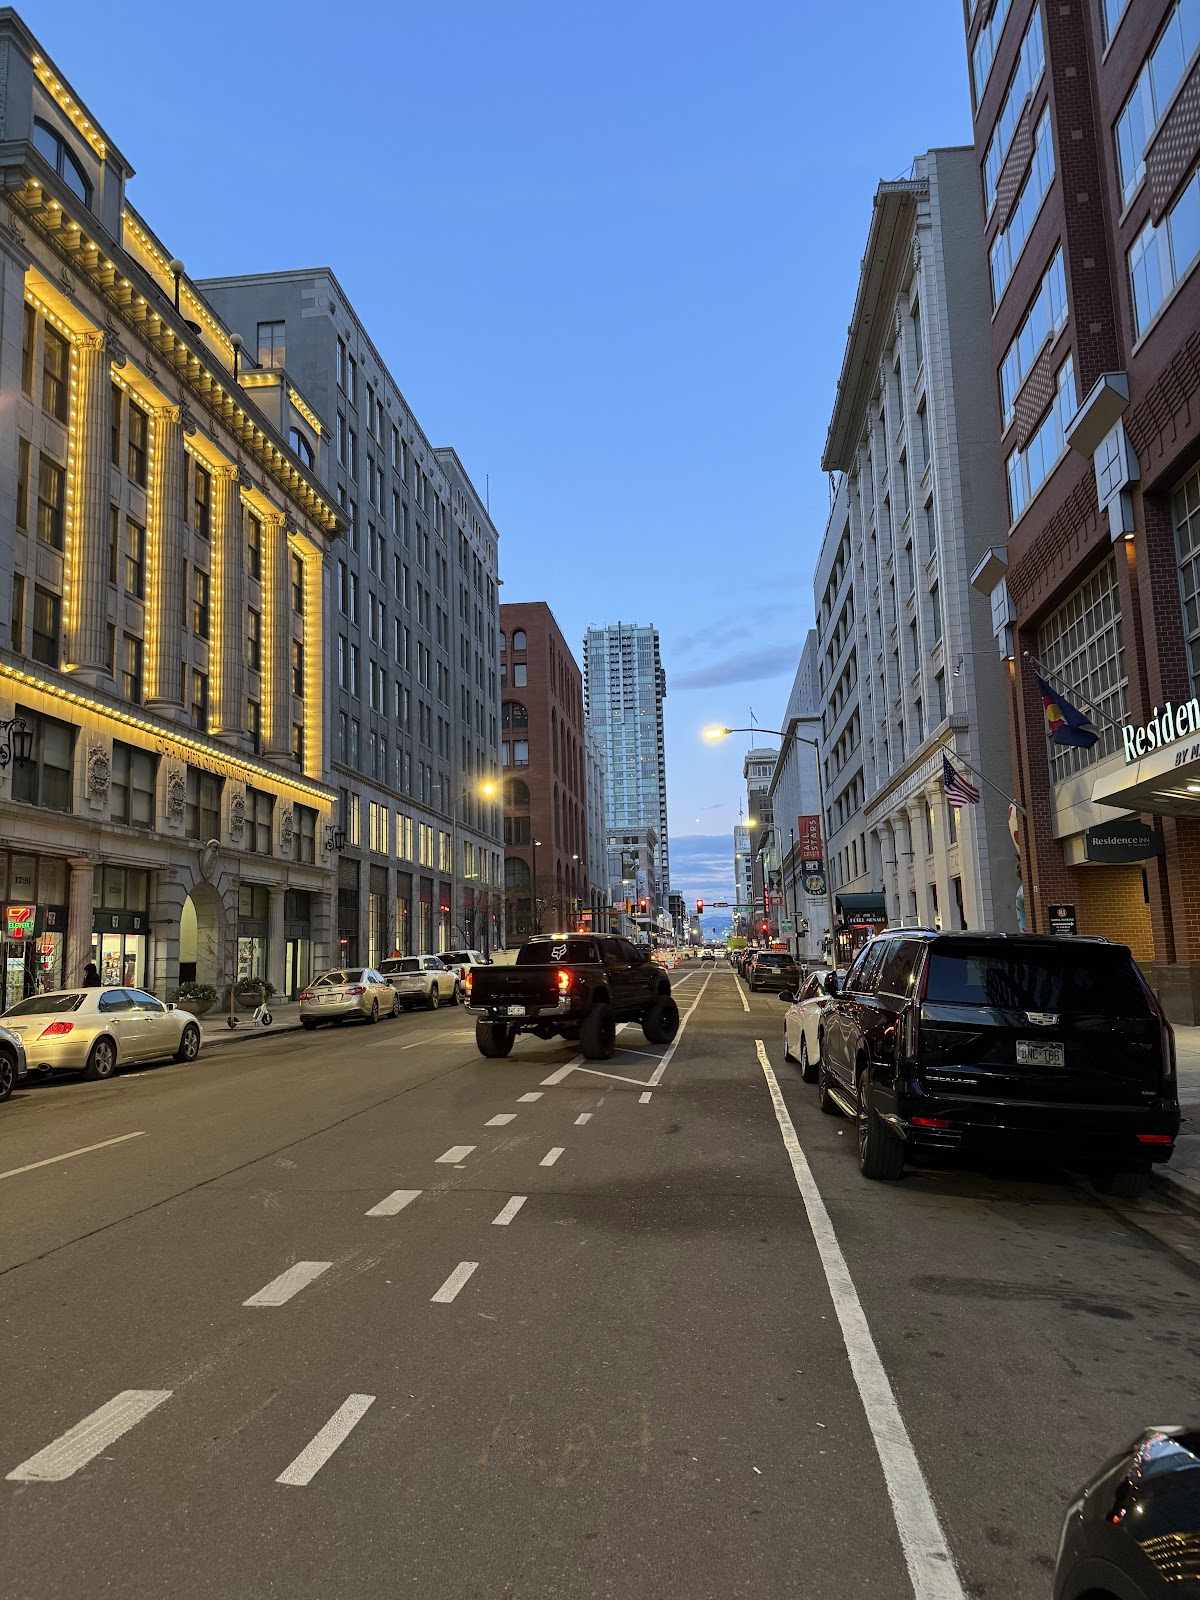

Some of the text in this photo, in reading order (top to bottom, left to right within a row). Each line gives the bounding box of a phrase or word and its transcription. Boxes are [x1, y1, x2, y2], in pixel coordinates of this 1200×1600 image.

[1121, 698, 1200, 763] Residen
[156, 738, 201, 768] CHAMBER
[1175, 743, 1200, 767] BY M
[802, 832, 810, 851] ALL
[809, 819, 819, 851] STARS
[1092, 836, 1138, 846] Residence
[15, 876, 31, 885] 1726
[6, 906, 31, 939] 7
